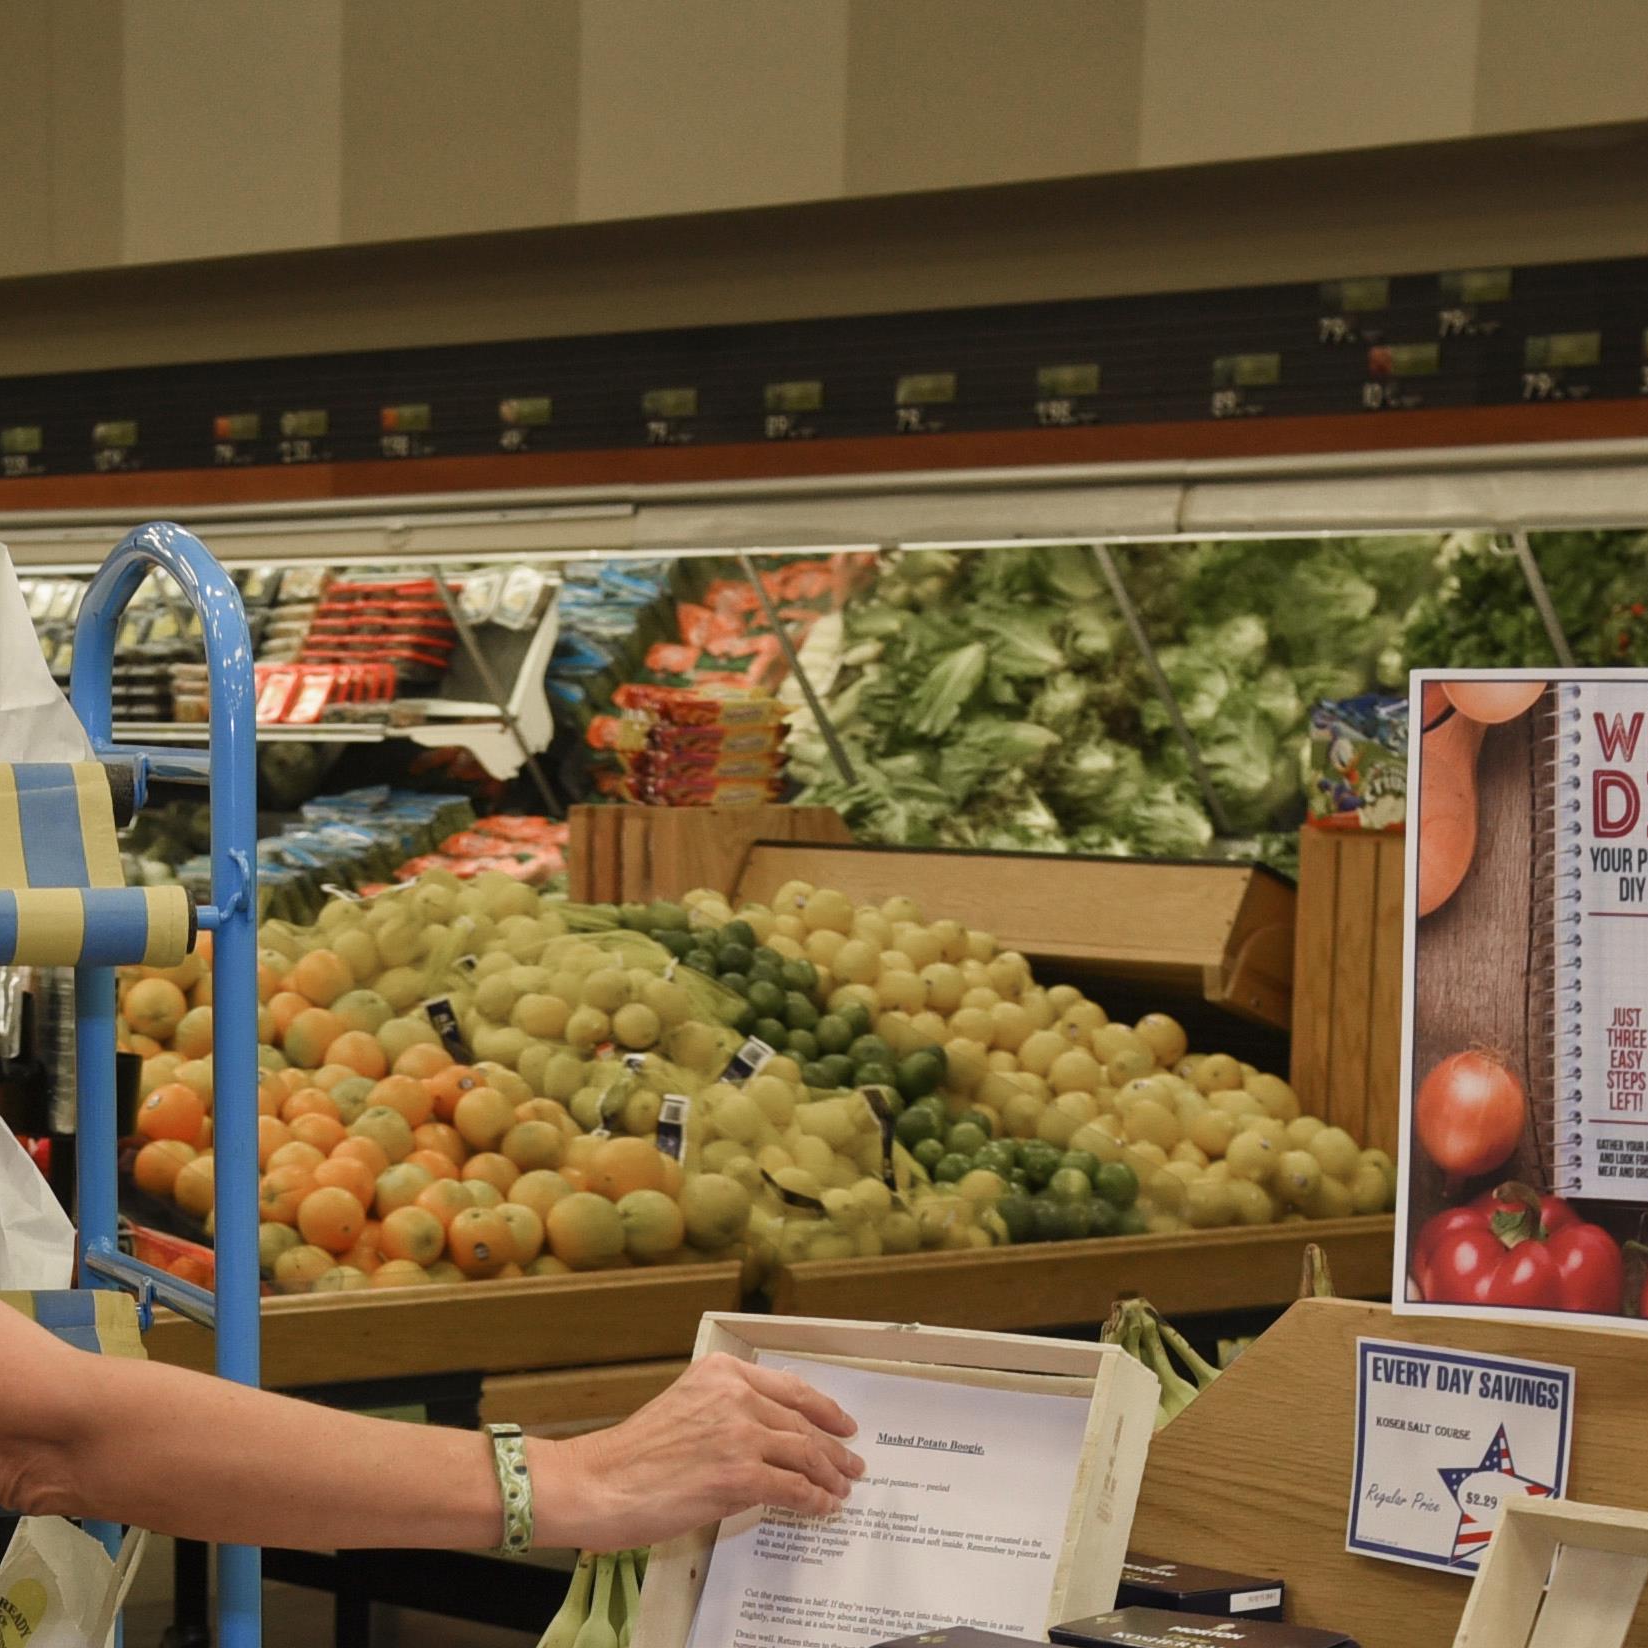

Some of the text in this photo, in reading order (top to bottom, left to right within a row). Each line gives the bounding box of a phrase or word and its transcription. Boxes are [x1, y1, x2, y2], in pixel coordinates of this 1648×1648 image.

[1591, 847, 1633, 873] YOUR
[1619, 877, 1645, 902] DIY
[1611, 1008, 1642, 1027] JUST
[1606, 1028, 1647, 1049] THREE
[1610, 1050, 1643, 1069] EASY
[1606, 1071, 1646, 1091] STEPS
[1609, 1091, 1643, 1112] LEFT!
[1372, 1357, 1560, 1410] EVERY DAY SAVINGS
[1376, 1416, 1471, 1440] KOSER SALT COURSE
[876, 1432, 914, 1446] Mashed
[917, 1437, 948, 1450] Potato
[1366, 1484, 1440, 1512] Regular Price
[1466, 1491, 1498, 1509] $2.29
